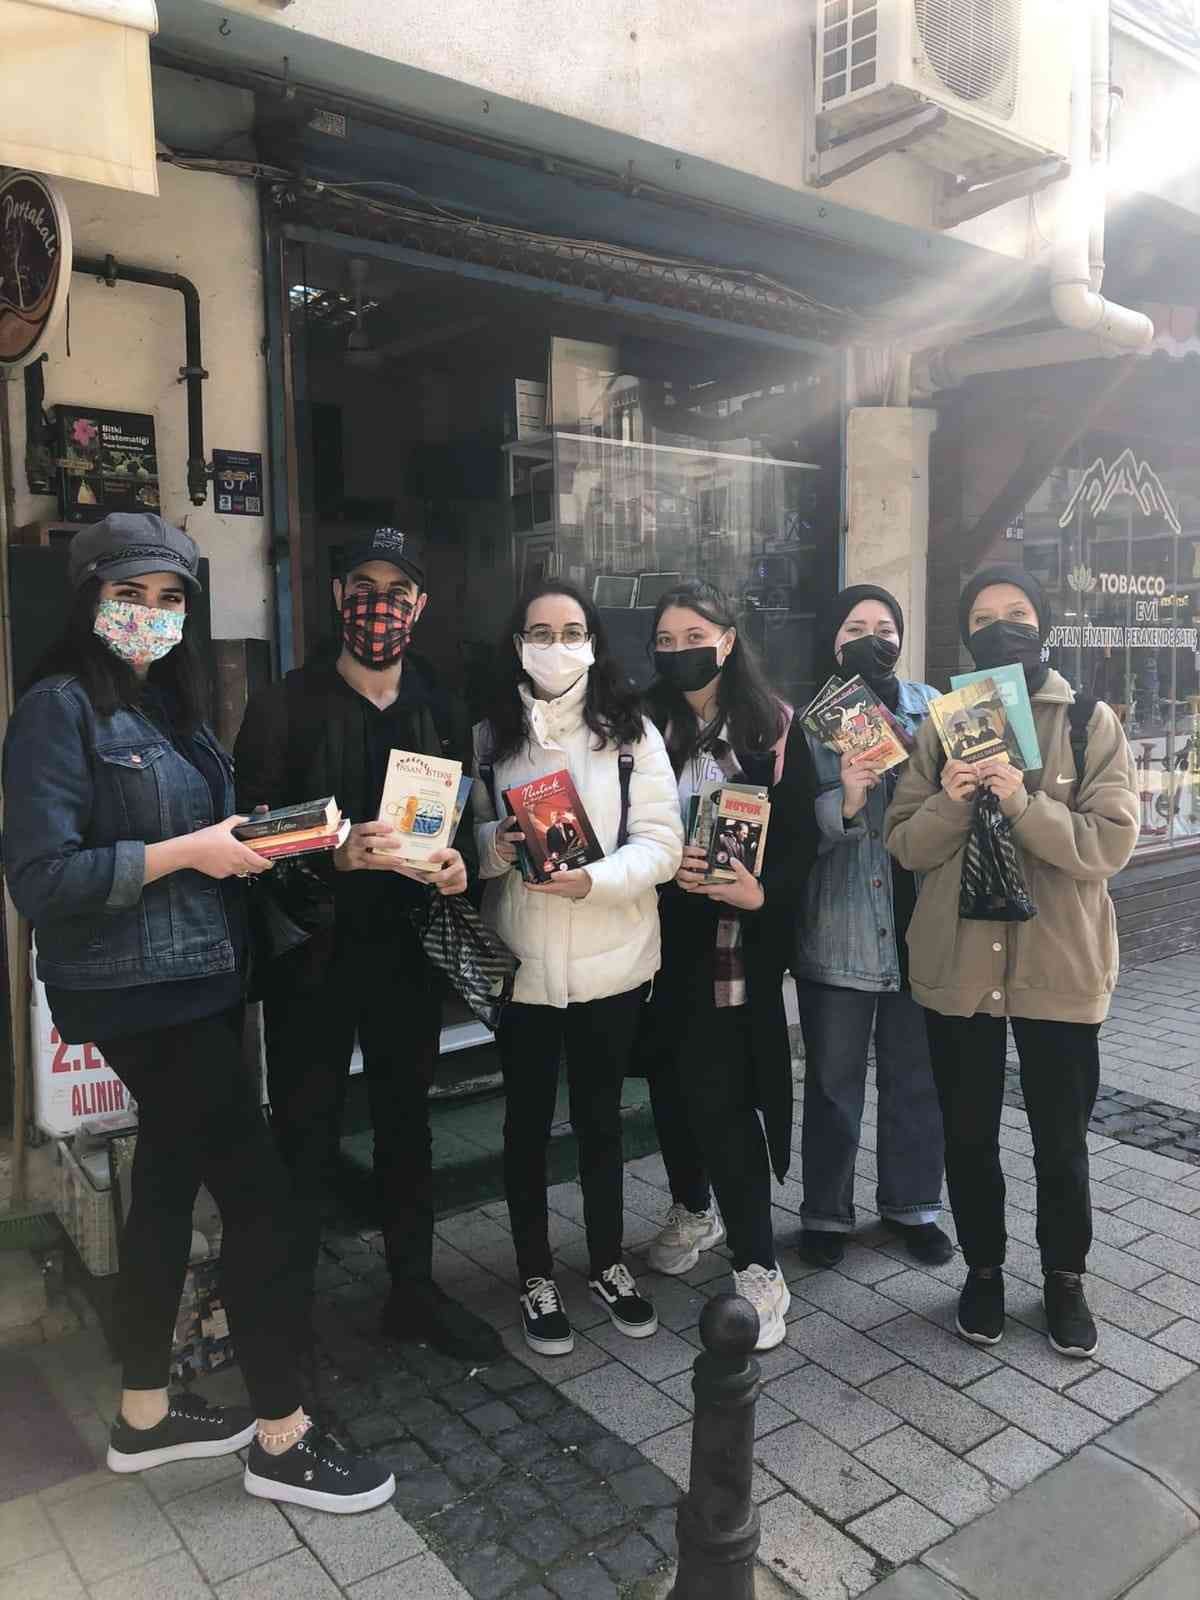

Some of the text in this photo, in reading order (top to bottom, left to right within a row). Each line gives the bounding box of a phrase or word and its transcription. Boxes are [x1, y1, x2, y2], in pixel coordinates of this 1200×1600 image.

[102, 424, 122, 434] Bitki
[1099, 573, 1165, 595] TOBACCO
[1043, 626, 1082, 648] OPTAN
[72, 1080, 124, 1115] ALINIR
